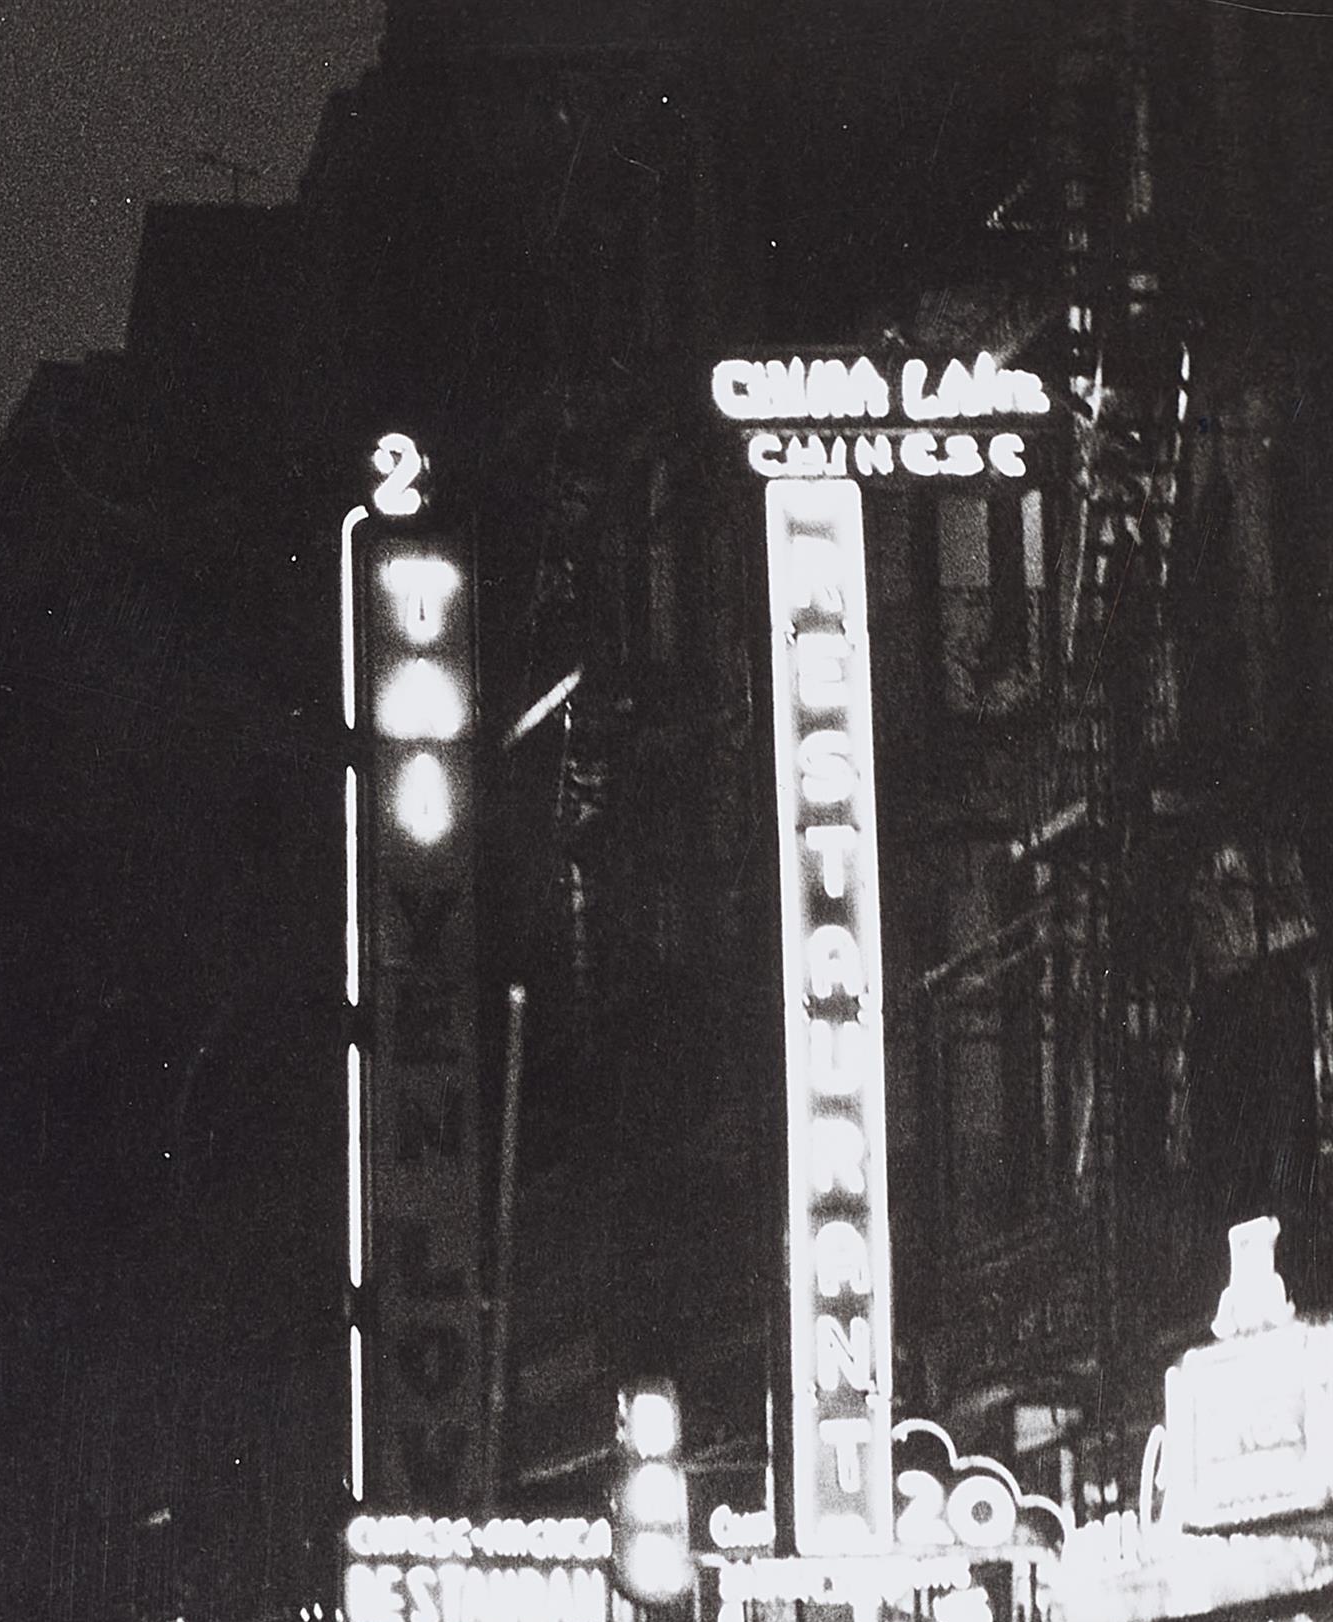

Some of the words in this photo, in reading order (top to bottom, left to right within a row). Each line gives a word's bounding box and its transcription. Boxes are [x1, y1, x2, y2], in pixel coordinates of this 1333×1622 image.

[749, 434, 1025, 477] CHINESE
[783, 533, 875, 1494] RESTAURANT
[896, 1470, 1014, 1547] 20
